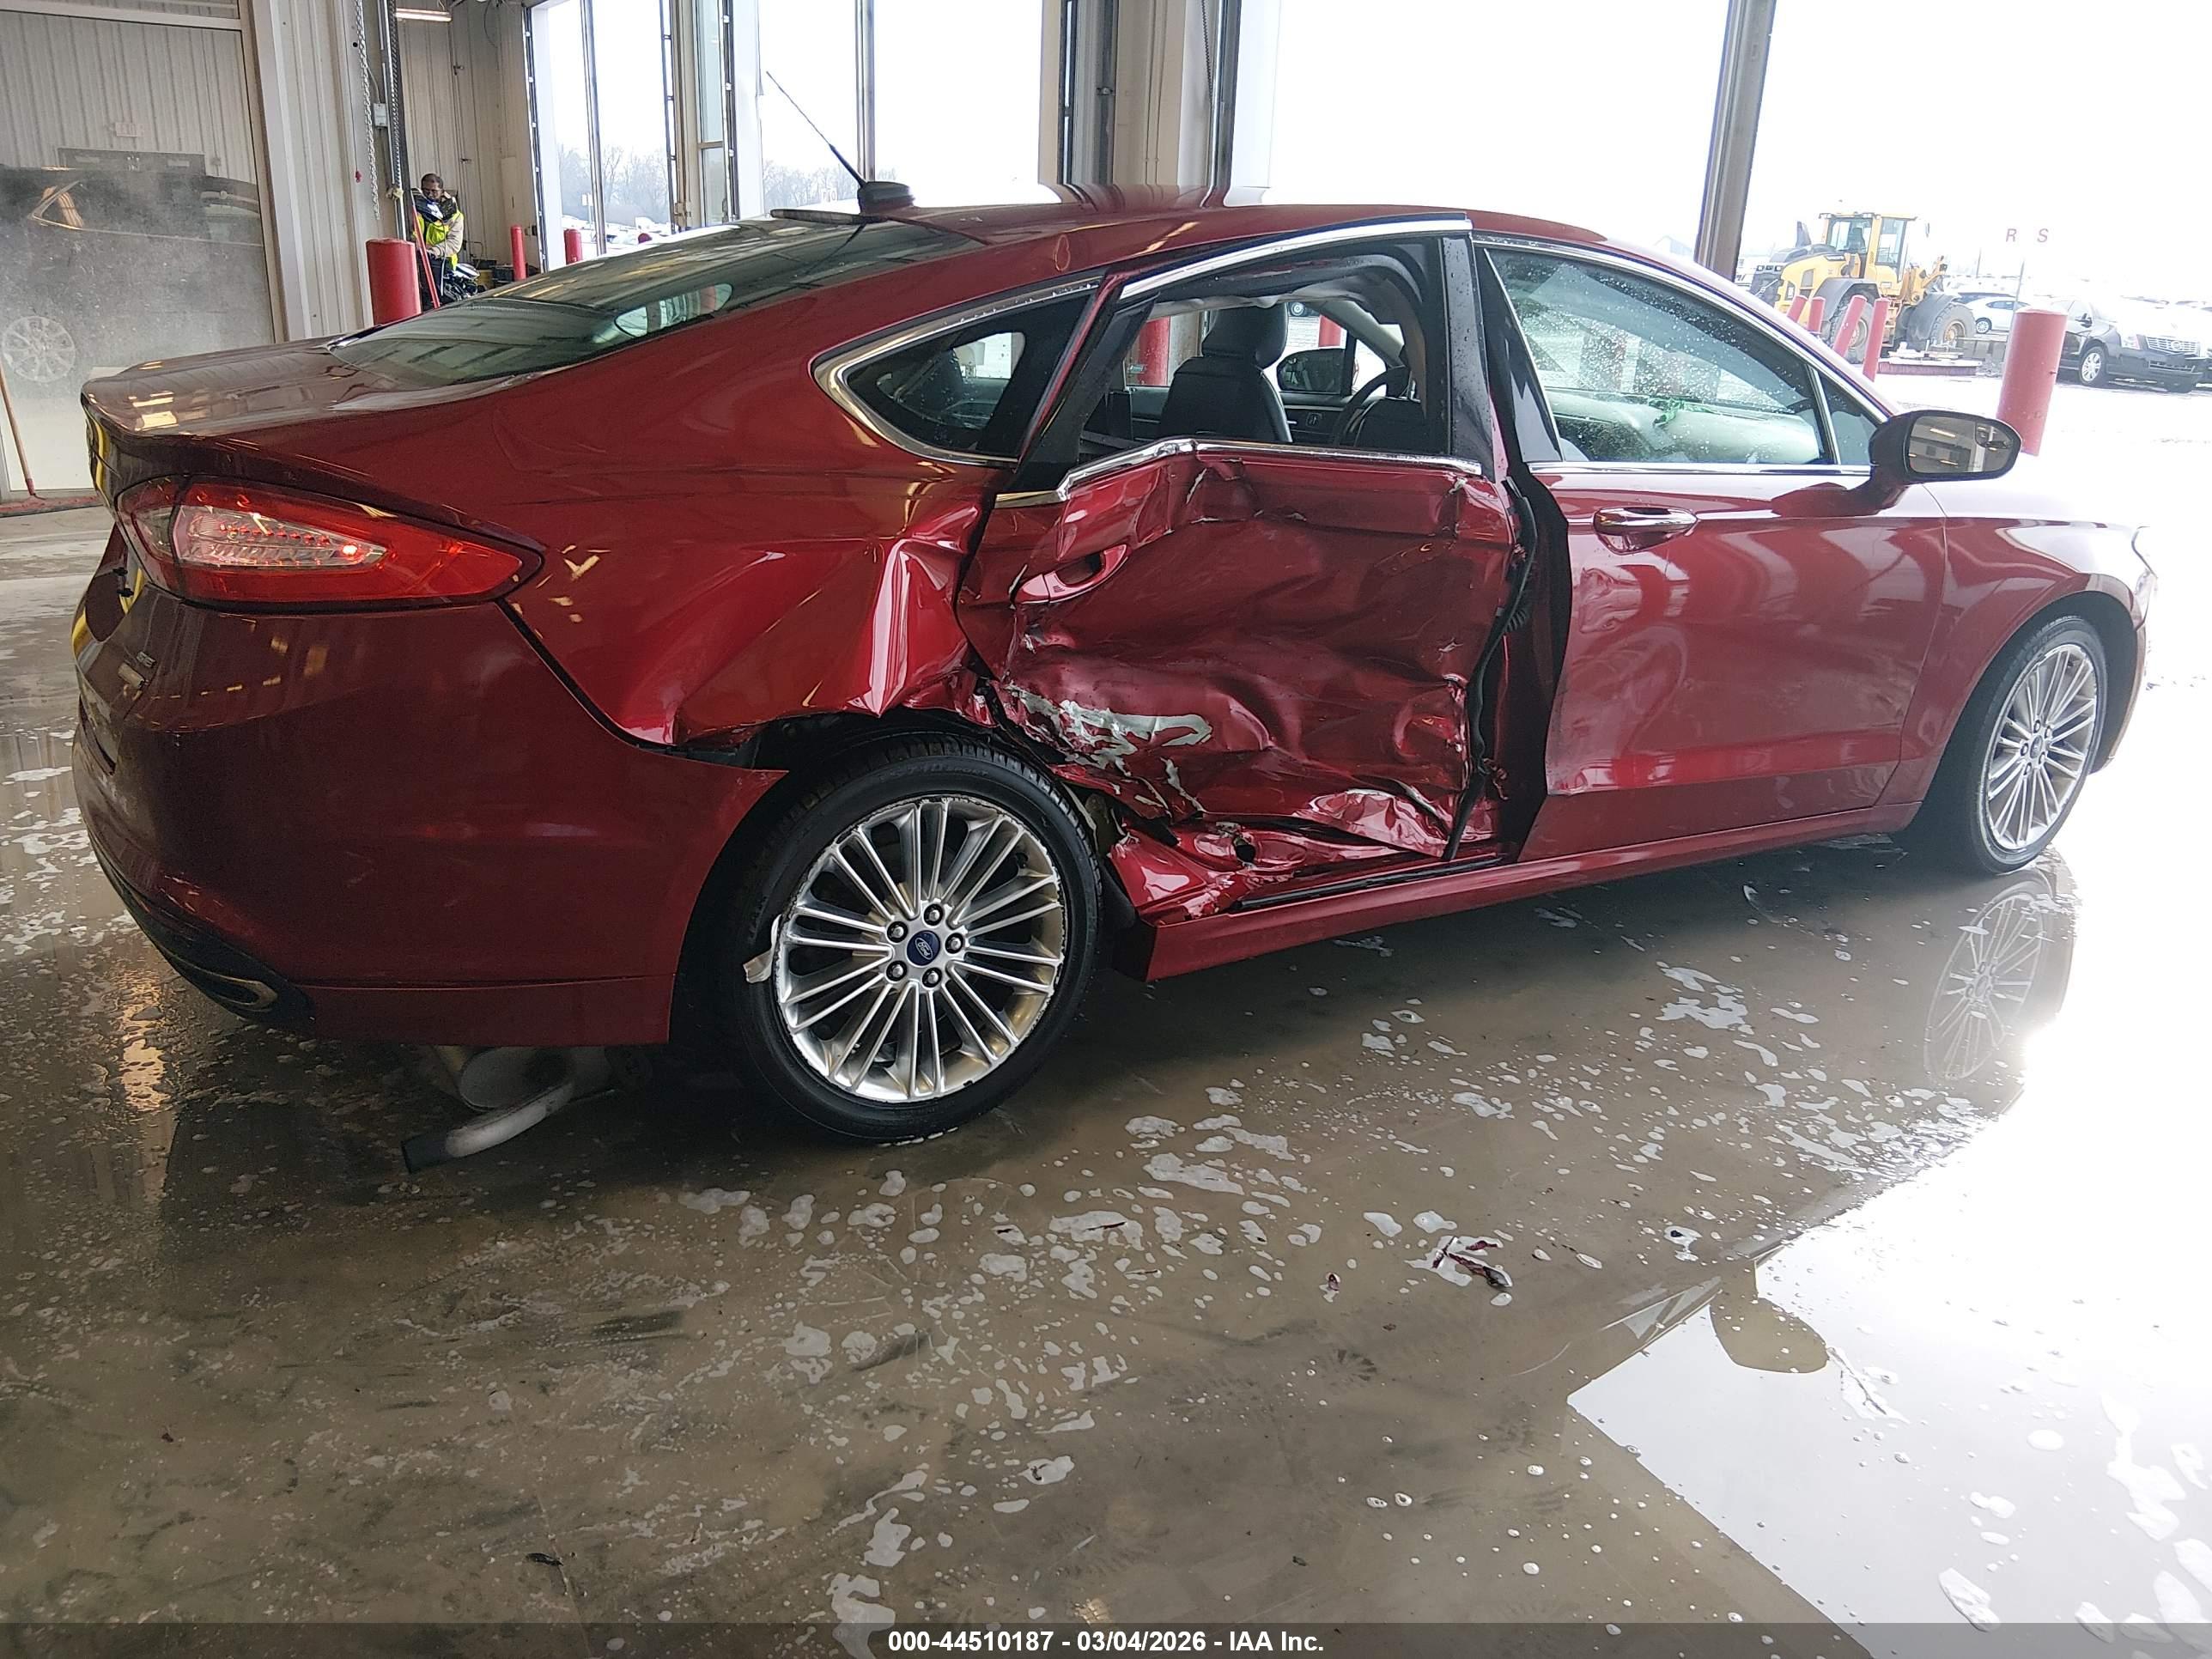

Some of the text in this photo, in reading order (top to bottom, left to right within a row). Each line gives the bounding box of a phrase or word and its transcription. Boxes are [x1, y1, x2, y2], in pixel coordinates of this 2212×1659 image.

[2006, 228, 2017, 242] R
[2037, 228, 2049, 243] S
[916, 939, 933, 959] Ford
